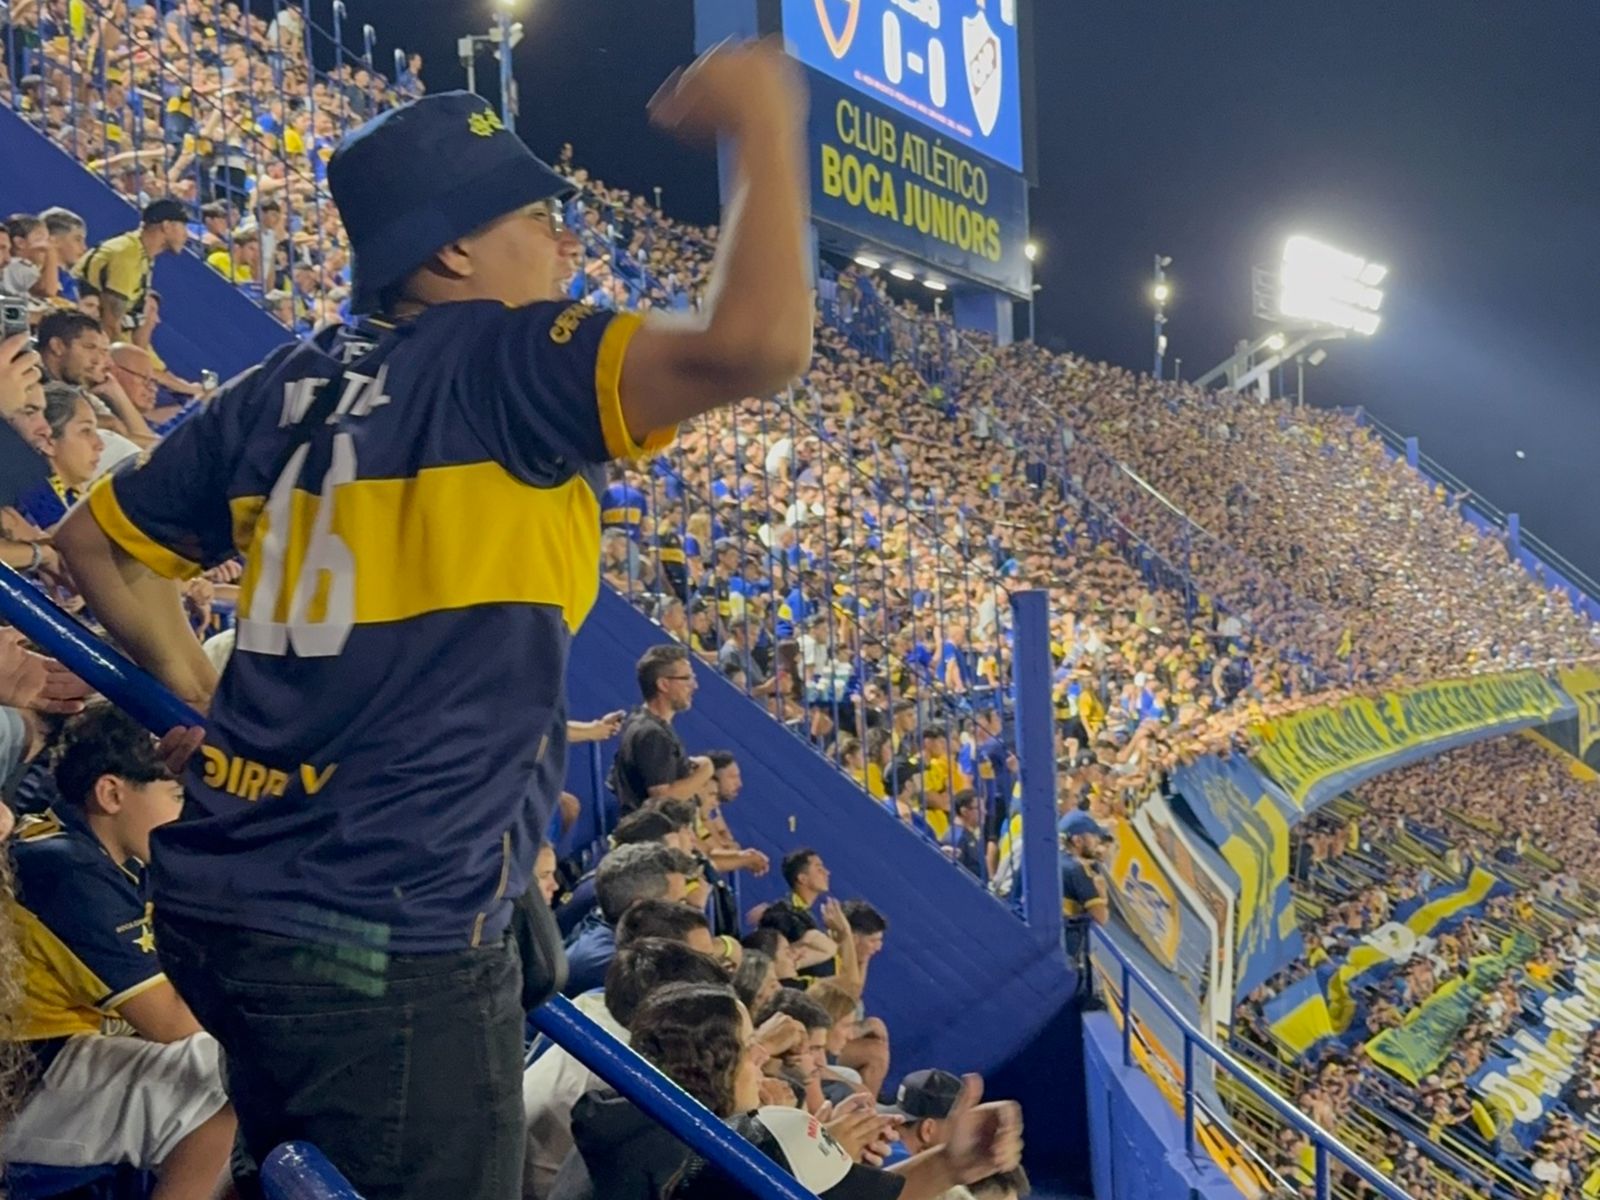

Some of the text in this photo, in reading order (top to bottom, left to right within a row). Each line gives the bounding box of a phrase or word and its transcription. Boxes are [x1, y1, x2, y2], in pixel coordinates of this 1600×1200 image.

[821, 144, 1001, 262] BOCA JUNIORS
[836, 99, 896, 163] CLUB
[901, 131, 988, 206] ATLÉTICO
[236, 432, 358, 657] 16
